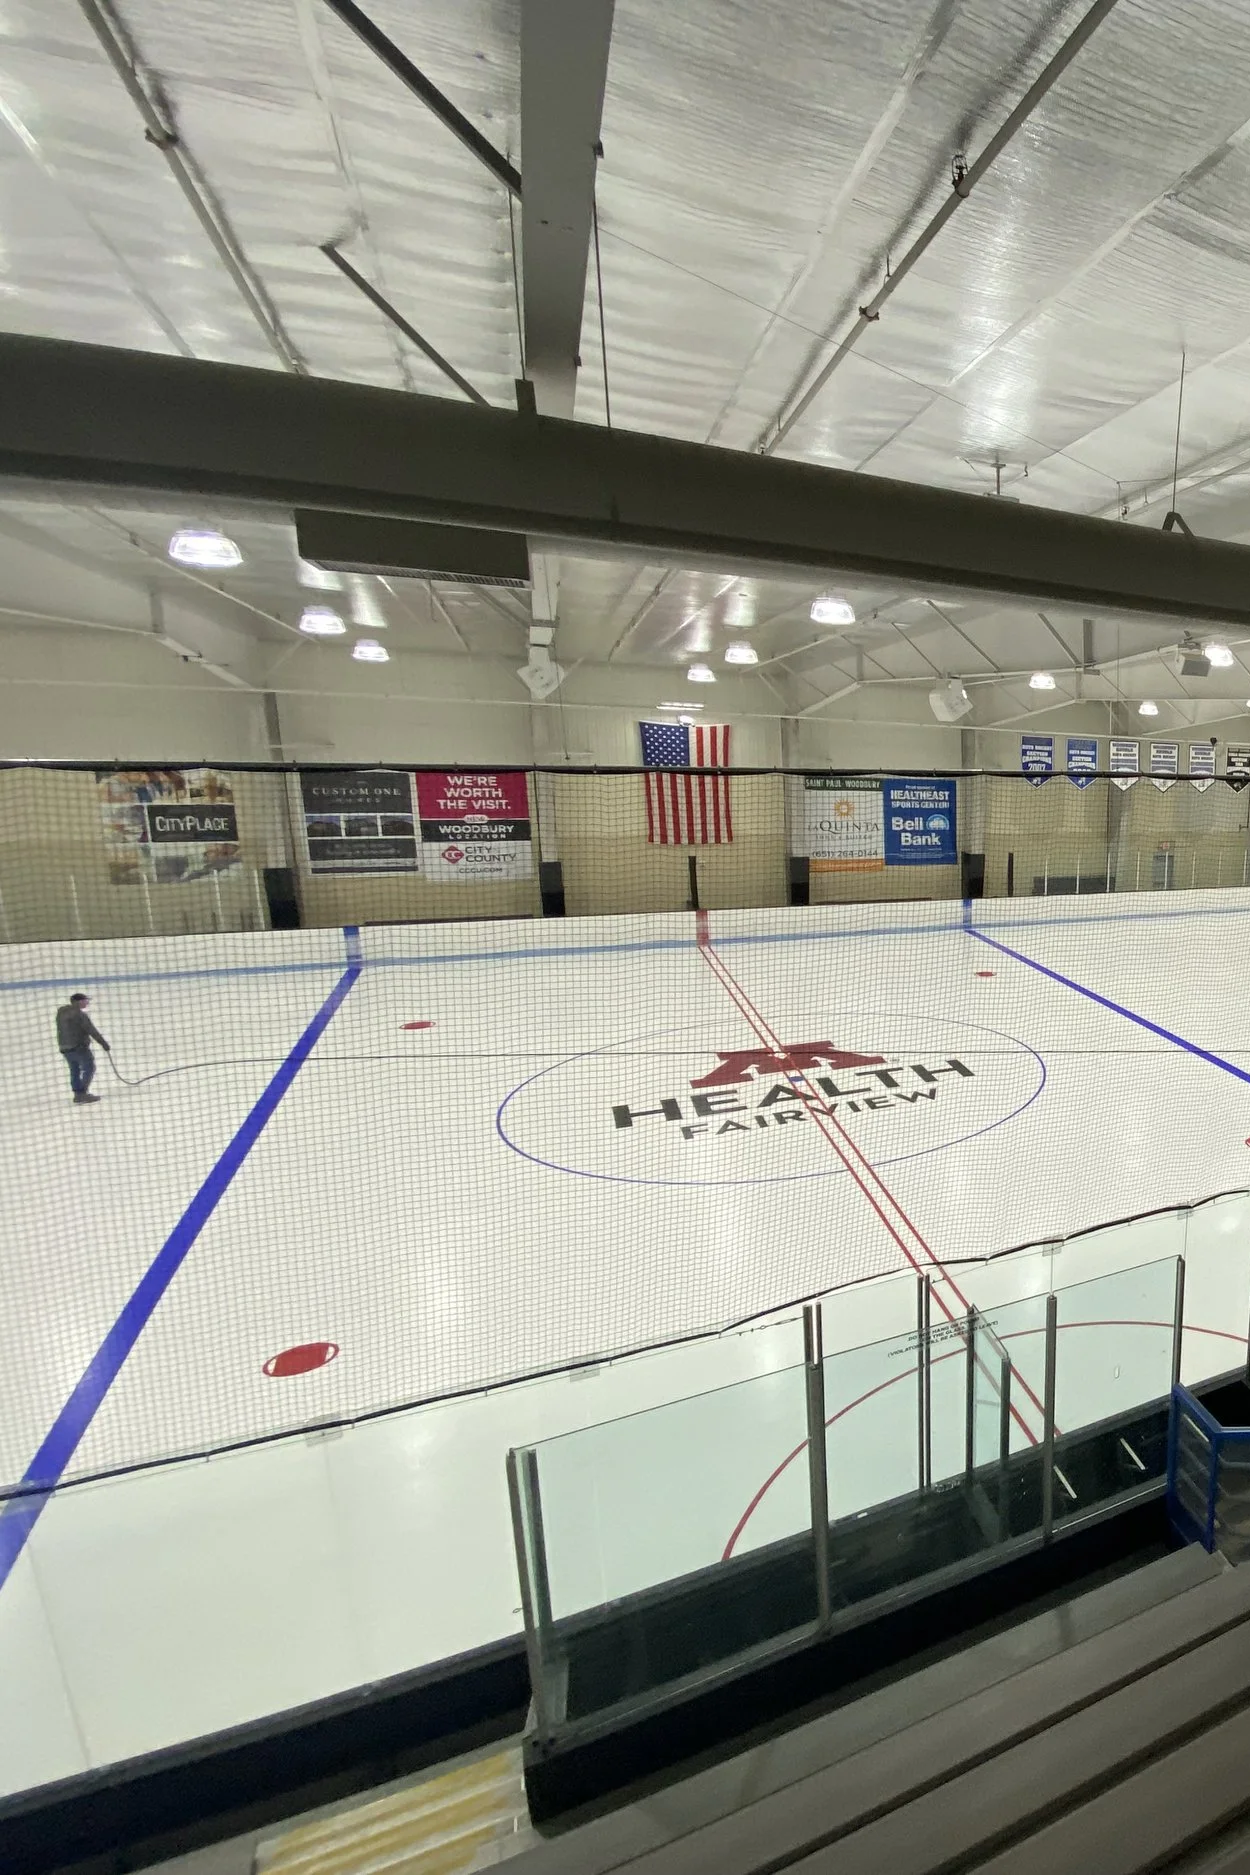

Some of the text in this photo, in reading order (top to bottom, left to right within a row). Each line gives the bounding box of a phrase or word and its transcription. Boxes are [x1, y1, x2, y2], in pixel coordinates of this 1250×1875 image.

[447, 775, 498, 786] WE'RE
[312, 787, 402, 796] CUSTOM ONE
[444, 787, 503, 798] WORTH
[890, 789, 950, 801] HEALTHEAST
[436, 799, 512, 810] THE VISIT.
[891, 800, 920, 809] SPORTS
[439, 824, 515, 834] WOODBURY
[891, 816, 924, 831] Bell
[900, 832, 942, 846] Bank
[465, 845, 493, 855] CITY
[465, 853, 517, 863] COUNTY
[612, 1059, 976, 1129] HEALTH
[681, 1088, 938, 1141] FAIRVIEW
